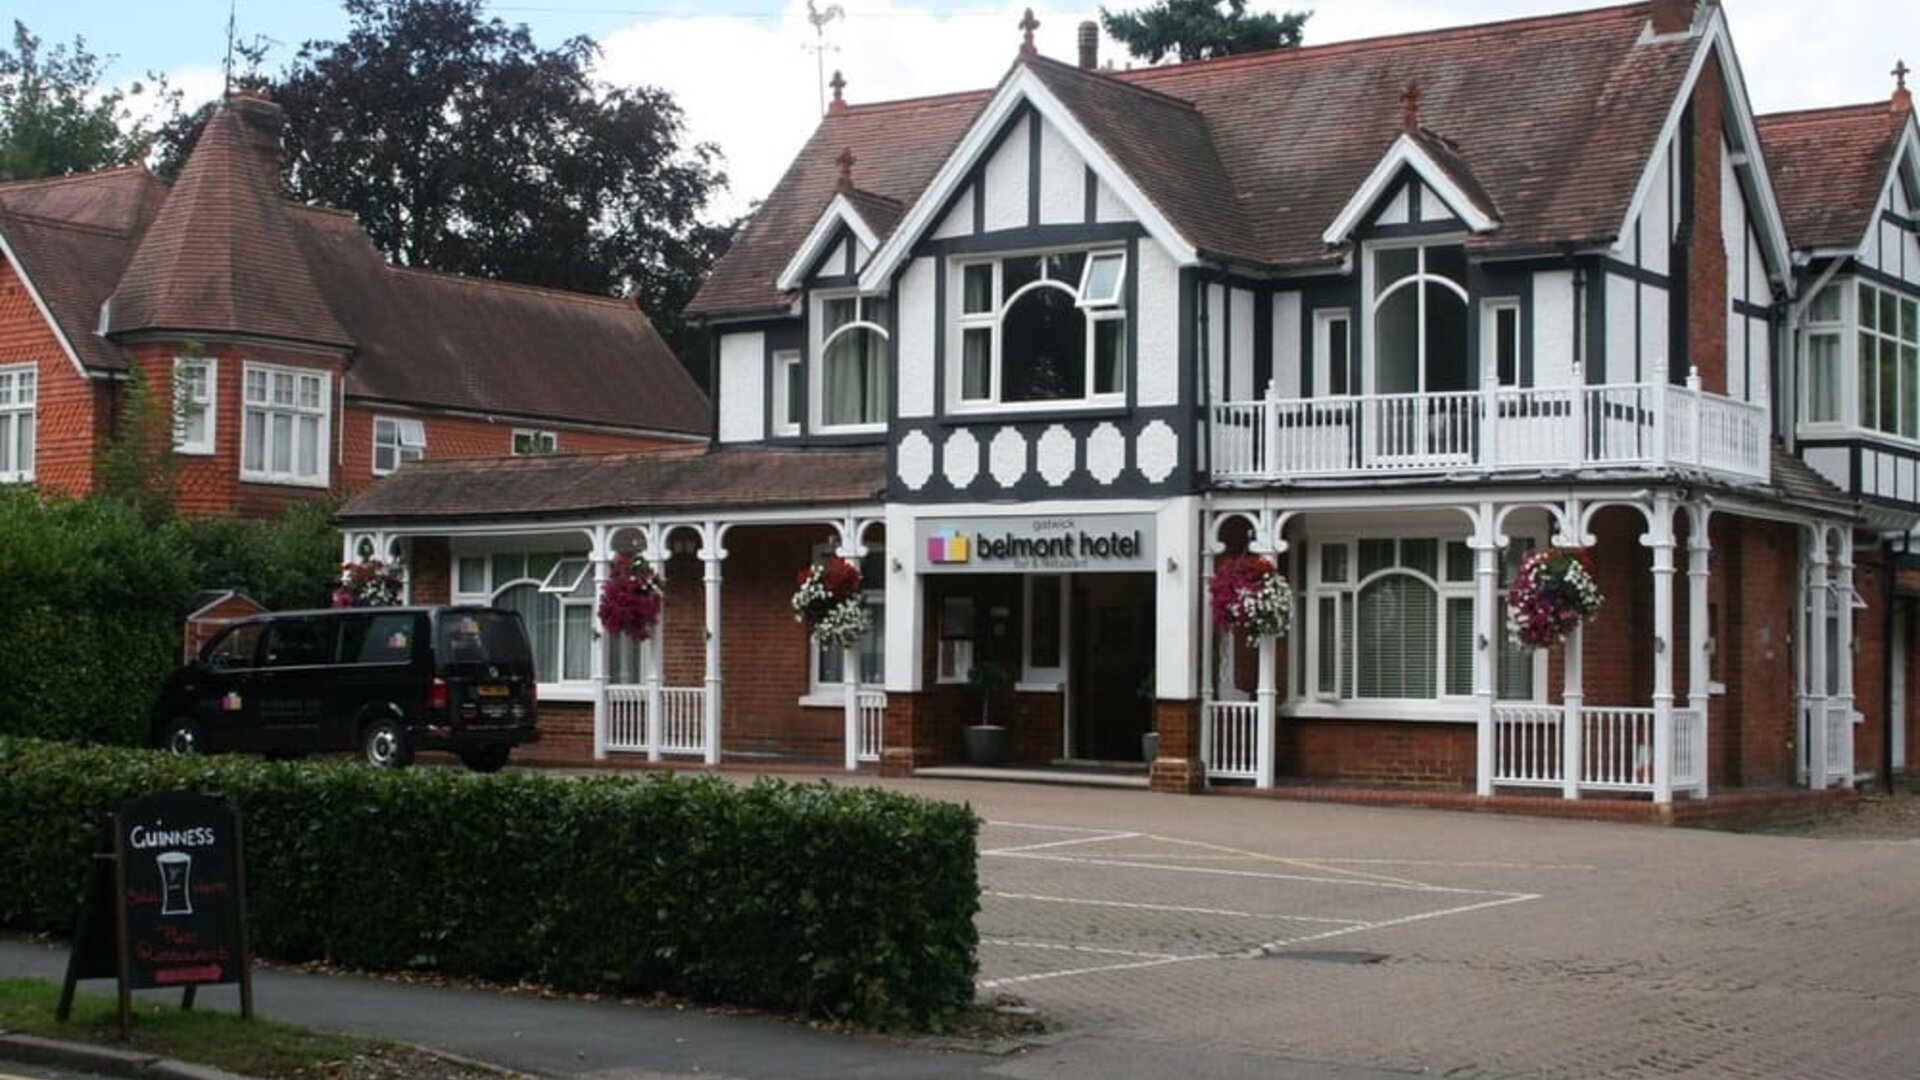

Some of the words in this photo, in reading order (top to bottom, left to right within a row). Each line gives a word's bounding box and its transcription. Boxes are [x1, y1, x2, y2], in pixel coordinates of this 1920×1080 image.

[977, 531, 1074, 559] belmont
[1080, 530, 1140, 558] hotel
[130, 826, 214, 848] GUINNESS
